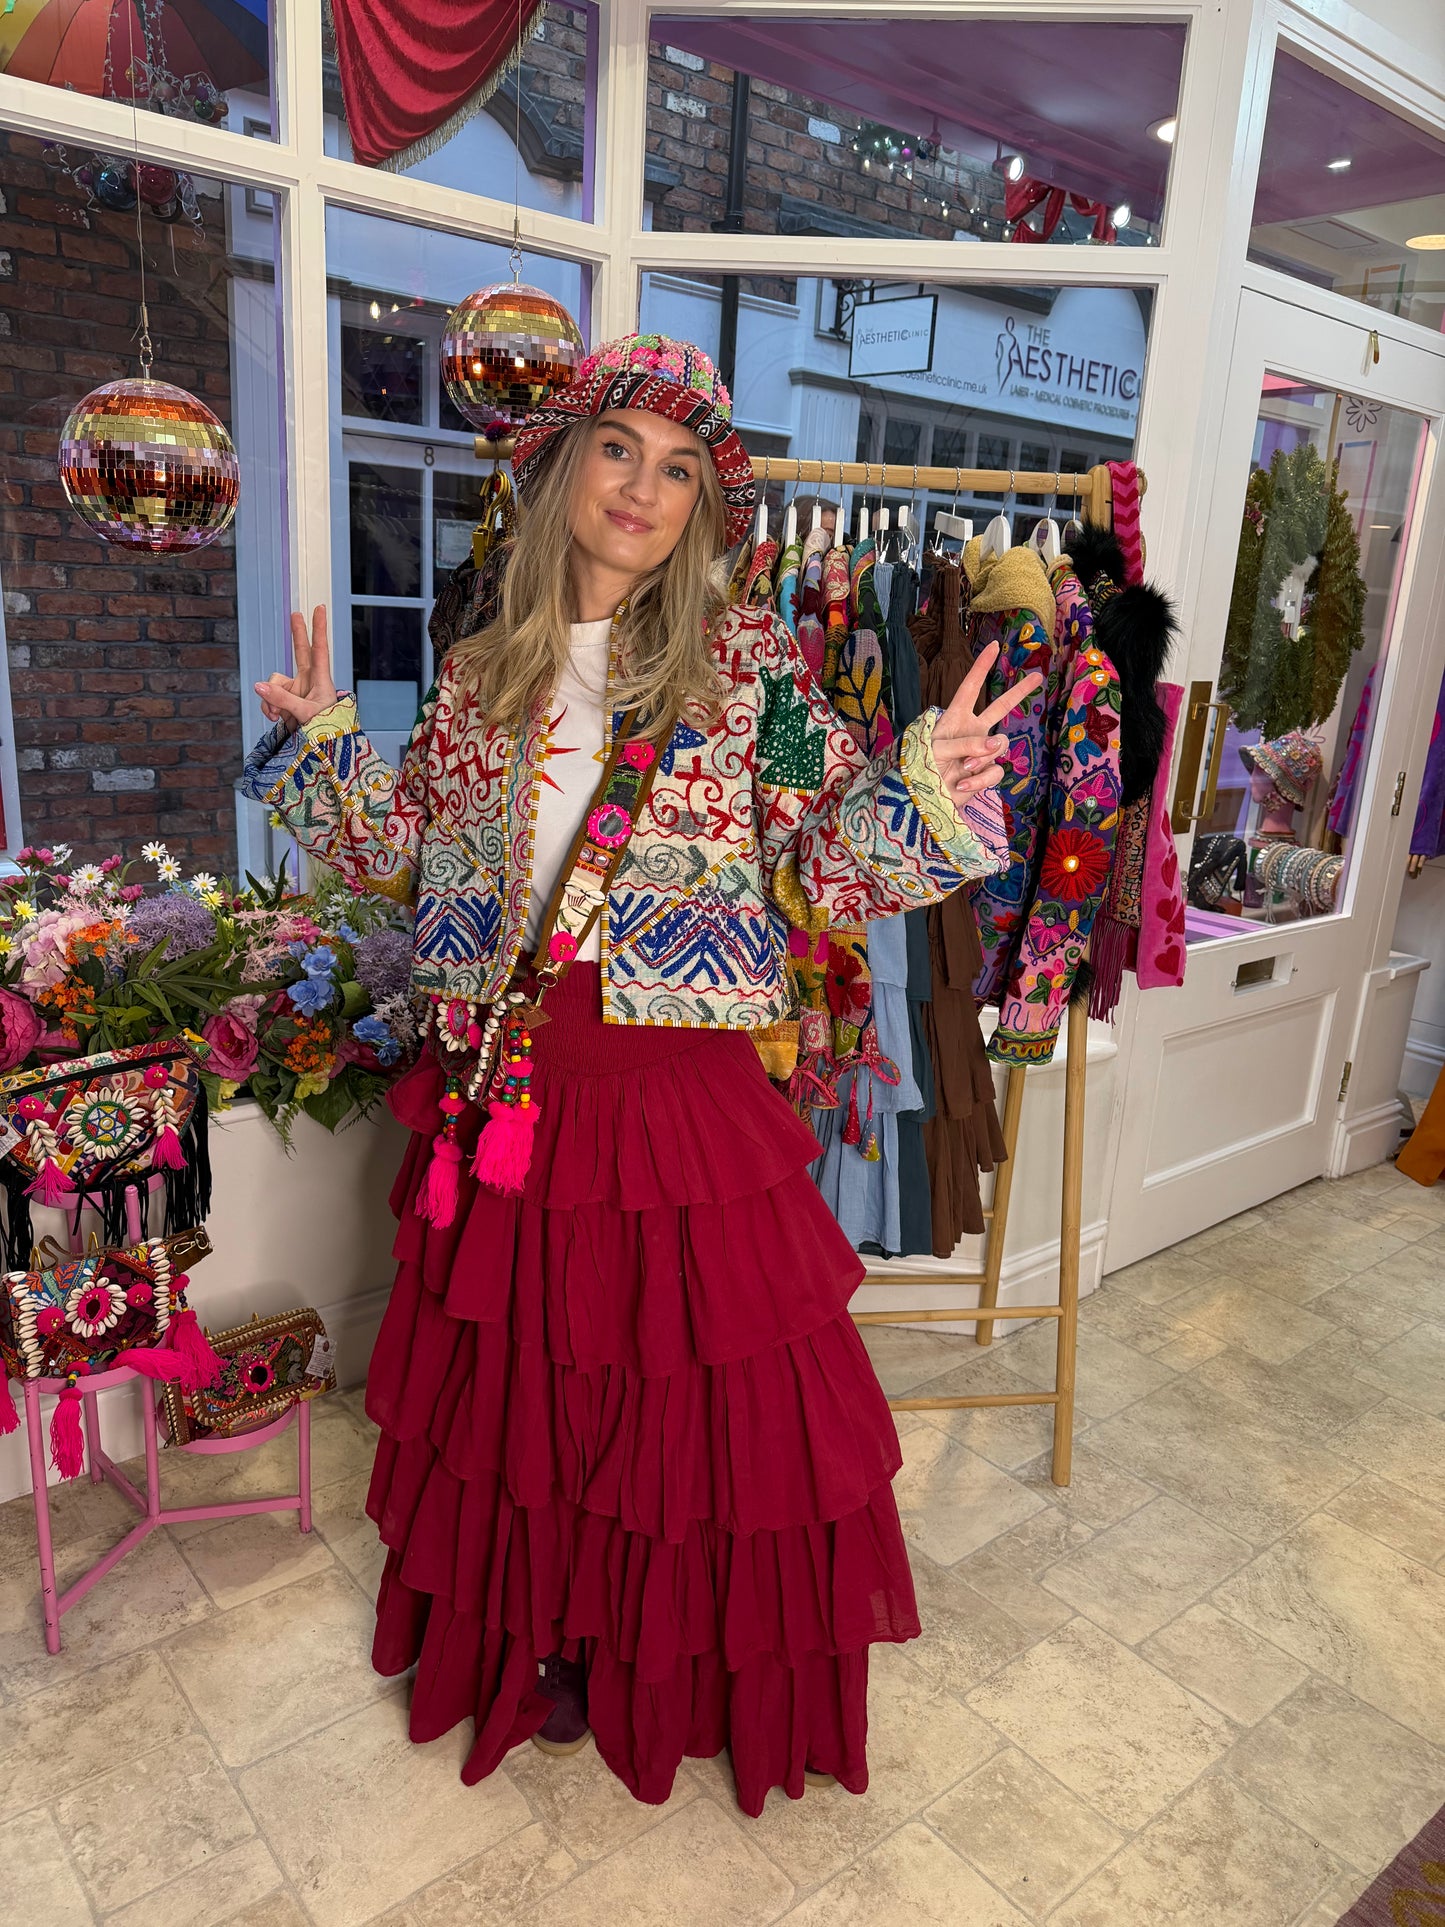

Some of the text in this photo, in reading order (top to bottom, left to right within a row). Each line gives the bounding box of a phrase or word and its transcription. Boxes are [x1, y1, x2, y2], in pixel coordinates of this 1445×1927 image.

[1027, 324, 1052, 347] THE
[1008, 343, 1138, 400] AESTHETIC
[1035, 389, 1061, 406] MEDICAL
[424, 446, 435, 467] 8
